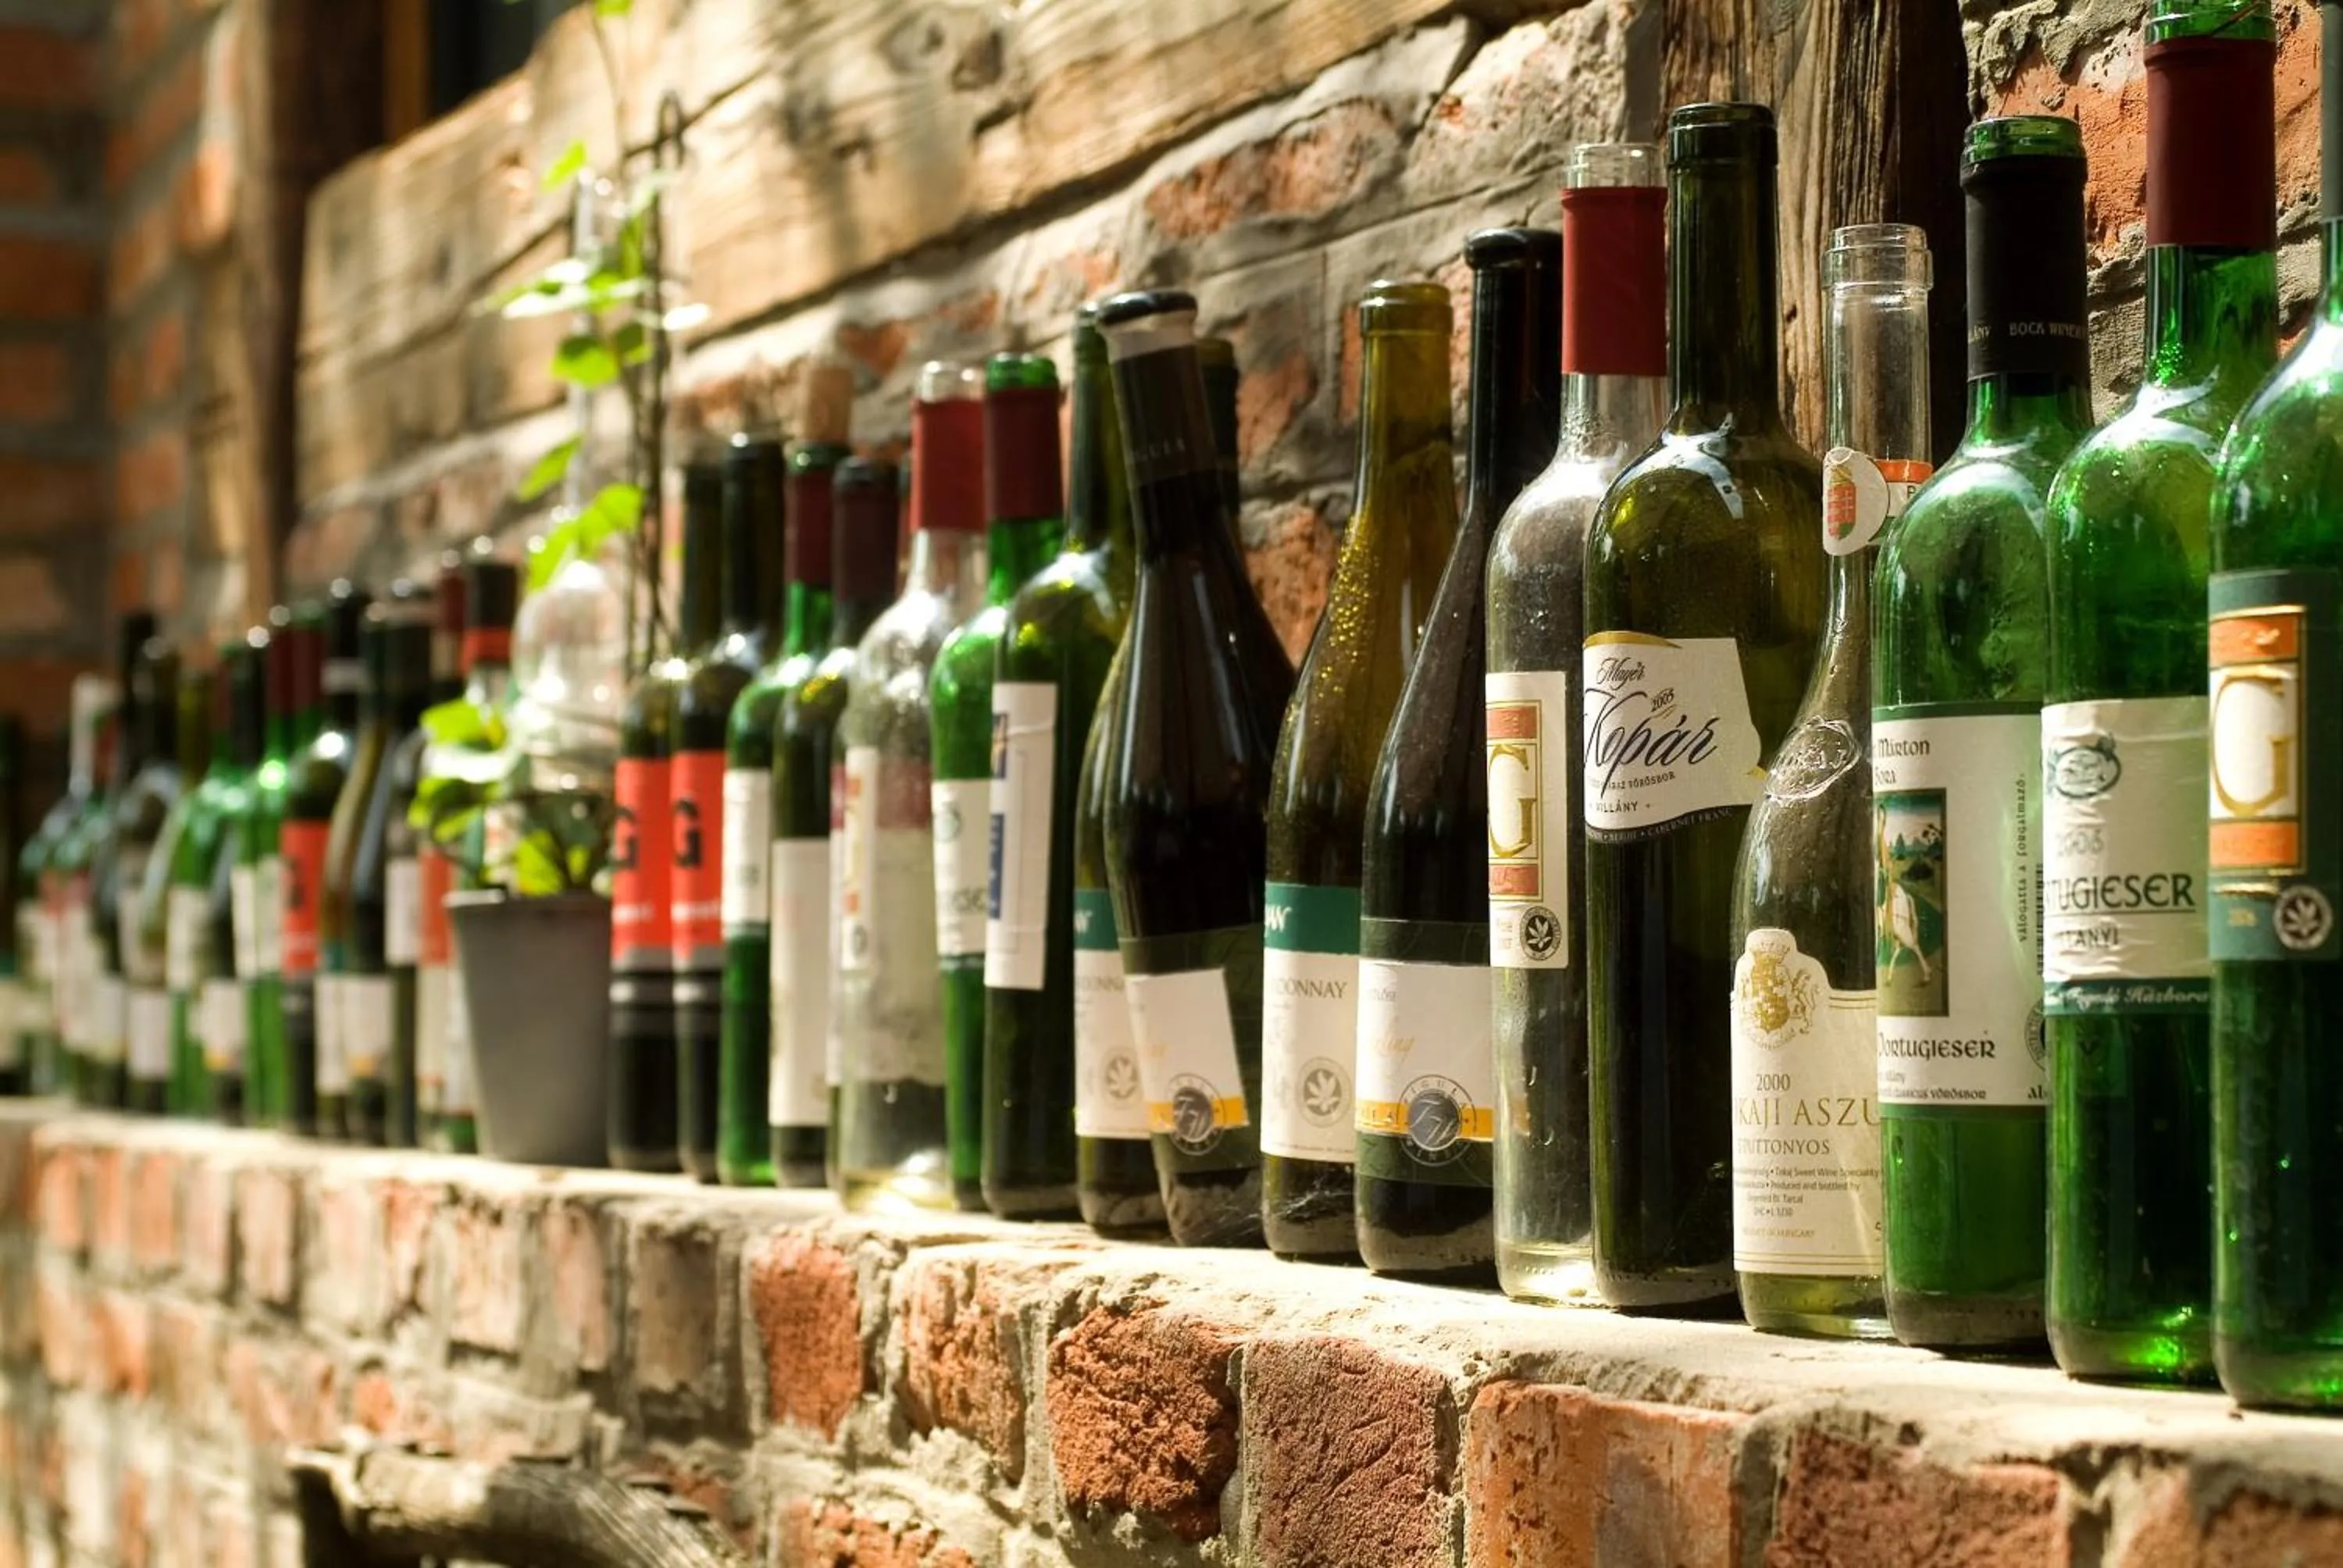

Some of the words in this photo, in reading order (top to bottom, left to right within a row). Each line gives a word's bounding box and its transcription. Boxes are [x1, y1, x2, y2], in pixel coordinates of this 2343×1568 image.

[2009, 321, 2045, 337] BOCK
[2045, 872, 2196, 912] TUGIESER
[1756, 1073, 1791, 1092] 2000
[1733, 1096, 1781, 1130] KAJI
